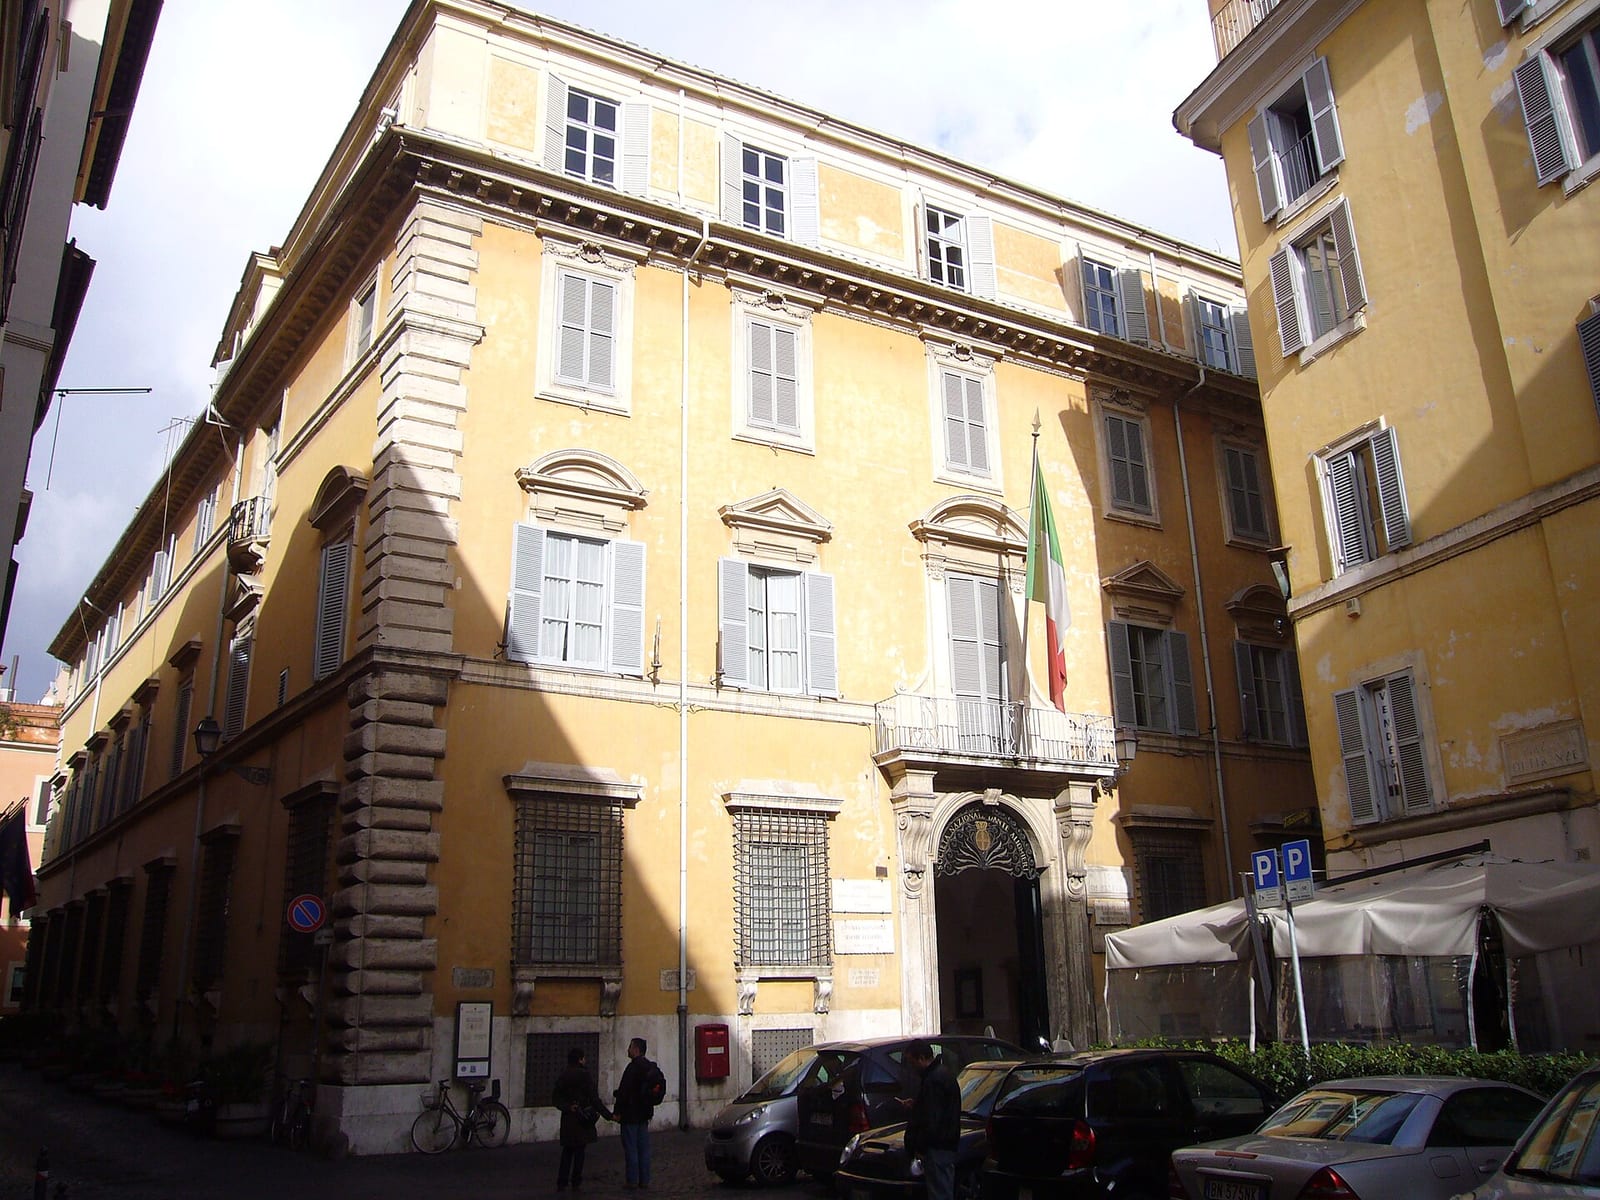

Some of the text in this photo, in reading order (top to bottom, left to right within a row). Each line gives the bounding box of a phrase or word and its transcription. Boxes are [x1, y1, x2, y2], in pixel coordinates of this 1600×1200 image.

[1378, 692, 1397, 782] VENDESI
[1256, 855, 1272, 886] P
[1288, 848, 1303, 875] P
